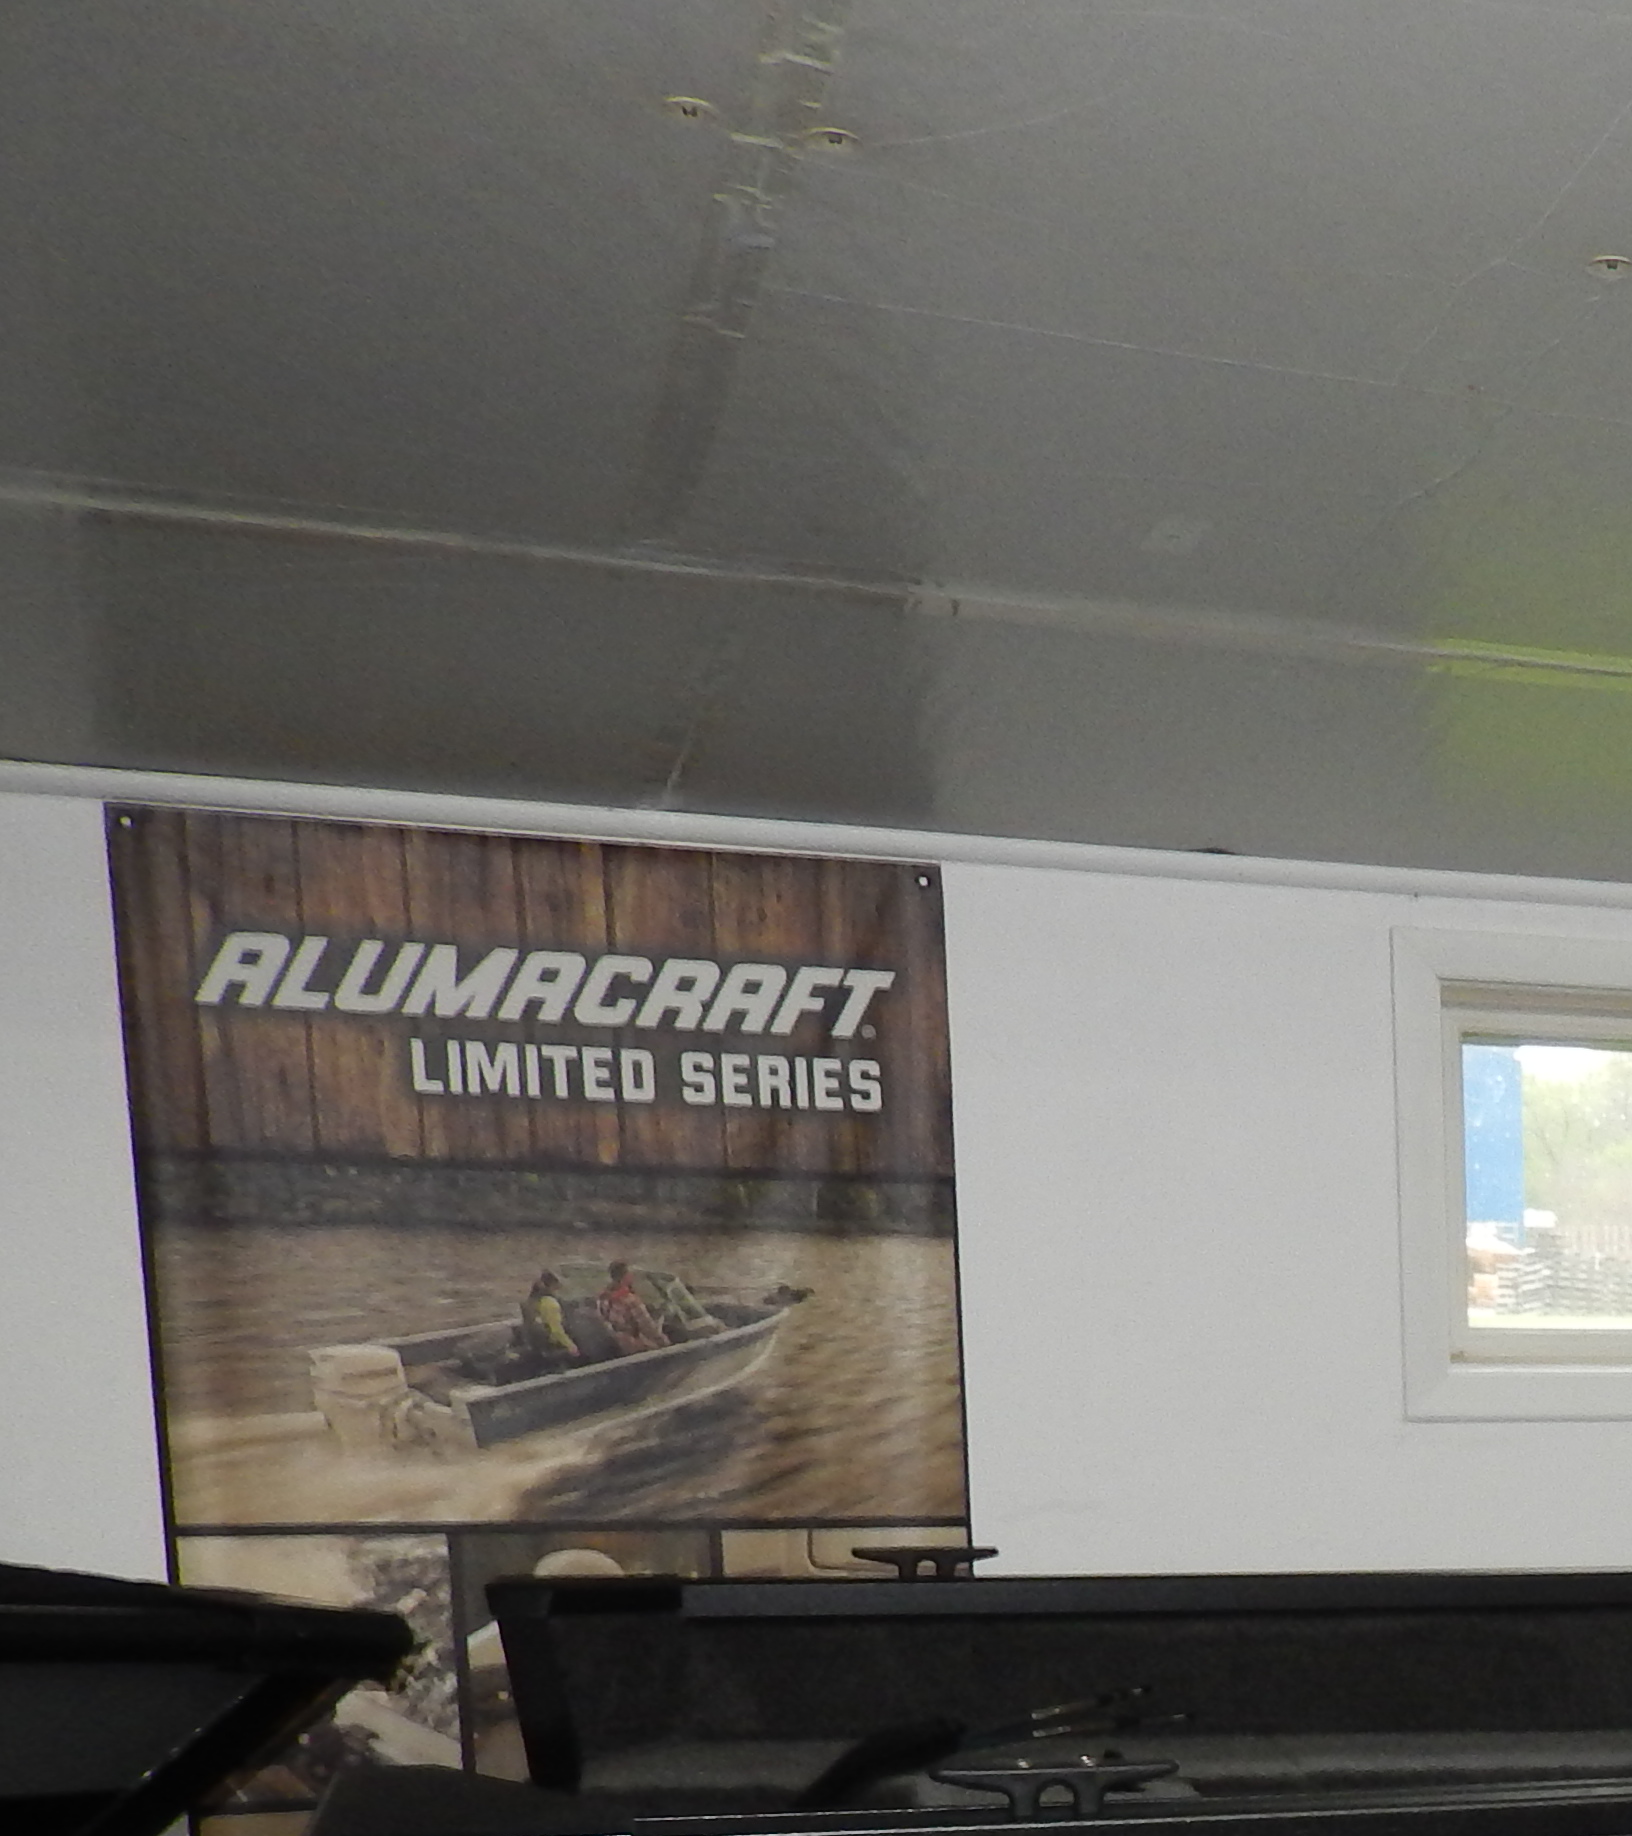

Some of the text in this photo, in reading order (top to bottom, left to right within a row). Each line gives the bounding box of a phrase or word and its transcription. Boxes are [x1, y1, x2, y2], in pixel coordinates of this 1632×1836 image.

[194, 931, 896, 1041] ALUMACRAFT
[410, 1037, 883, 1113] LIMITED SERIES
